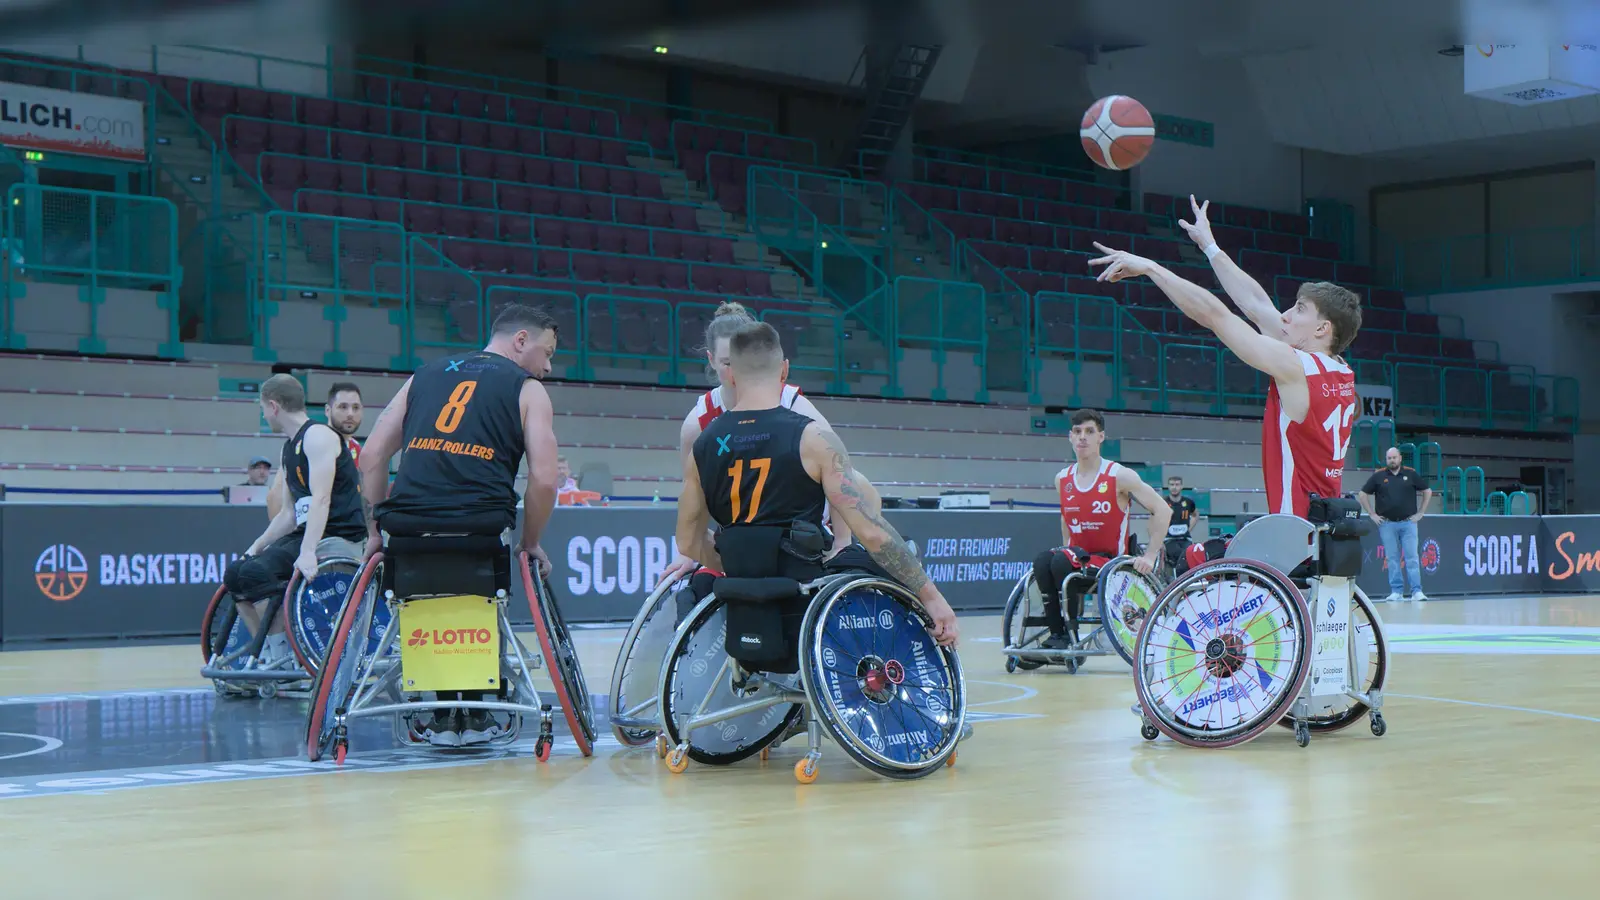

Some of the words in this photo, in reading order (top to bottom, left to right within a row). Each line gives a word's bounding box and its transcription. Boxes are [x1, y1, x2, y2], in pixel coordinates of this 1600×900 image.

[434, 380, 477, 434] 8
[1362, 396, 1392, 417] KFZ
[733, 432, 771, 443] Carstens
[442, 440, 495, 460] ROLLERS
[728, 457, 771, 524] 17
[1091, 501, 1111, 513] 20
[925, 538, 957, 557] JEDER
[959, 537, 1011, 556] FREIWURF
[1464, 534, 1522, 576] SCORE
[1527, 534, 1539, 574] A
[100, 553, 237, 585] BASKETBAL
[567, 535, 678, 595] SCOR
[926, 562, 954, 582] KANN
[956, 561, 990, 582] ETWAS
[1216, 594, 1264, 628] BECHERT
[838, 614, 877, 630] Allianz
[1316, 622, 1347, 634] schlaeger
[433, 628, 491, 645] LOTTO
[886, 729, 929, 748] Allianz
